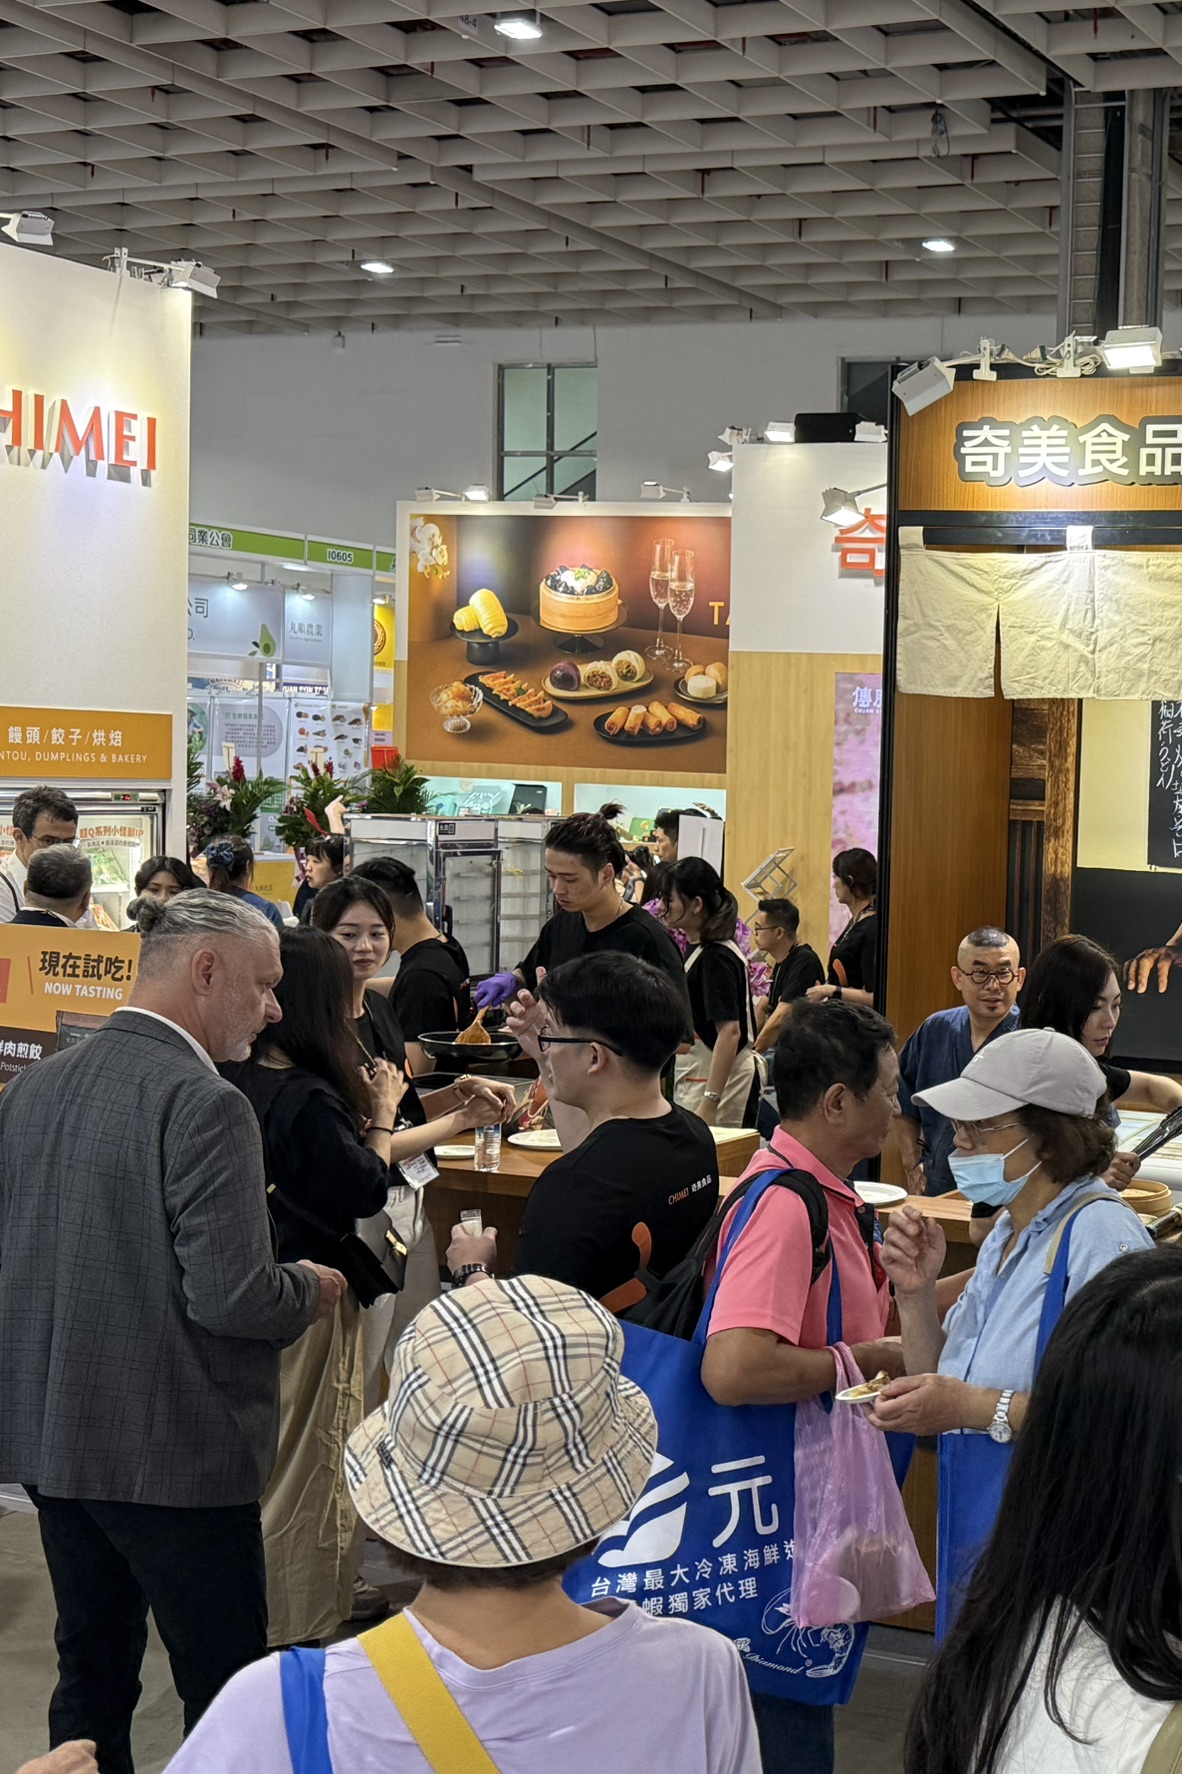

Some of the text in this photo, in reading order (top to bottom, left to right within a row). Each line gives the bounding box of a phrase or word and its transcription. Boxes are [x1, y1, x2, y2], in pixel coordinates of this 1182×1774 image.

[708, 602, 731, 626] T
[8, 726, 123, 748] 饅頭/餃子/烘焙
[35, 751, 96, 763] DUMPLINGS
[100, 753, 107, 762] &
[111, 754, 148, 764] BAKERY
[38, 950, 133, 983] 現在試吃!
[44, 982, 123, 1000] NOW TASTING
[667, 1187, 690, 1206] CHIMEI
[707, 1454, 780, 1549] 元
[636, 1576, 759, 1618] 蝦獨家代理
